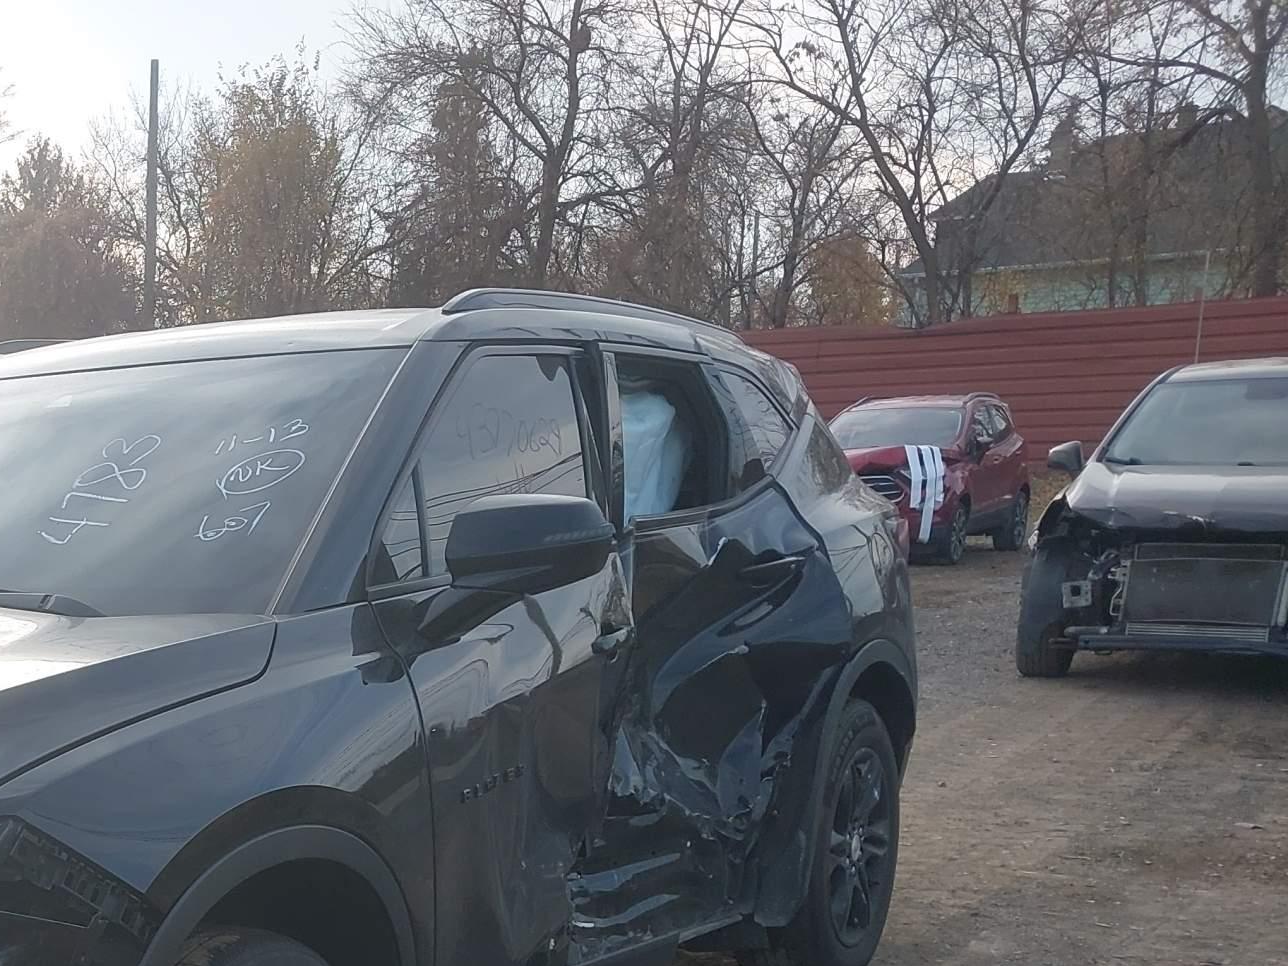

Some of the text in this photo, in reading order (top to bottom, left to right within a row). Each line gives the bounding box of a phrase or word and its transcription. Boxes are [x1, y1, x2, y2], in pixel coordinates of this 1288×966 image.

[215, 418, 310, 454] 11-13
[37, 434, 161, 545] 4783
[193, 500, 272, 542] 607
